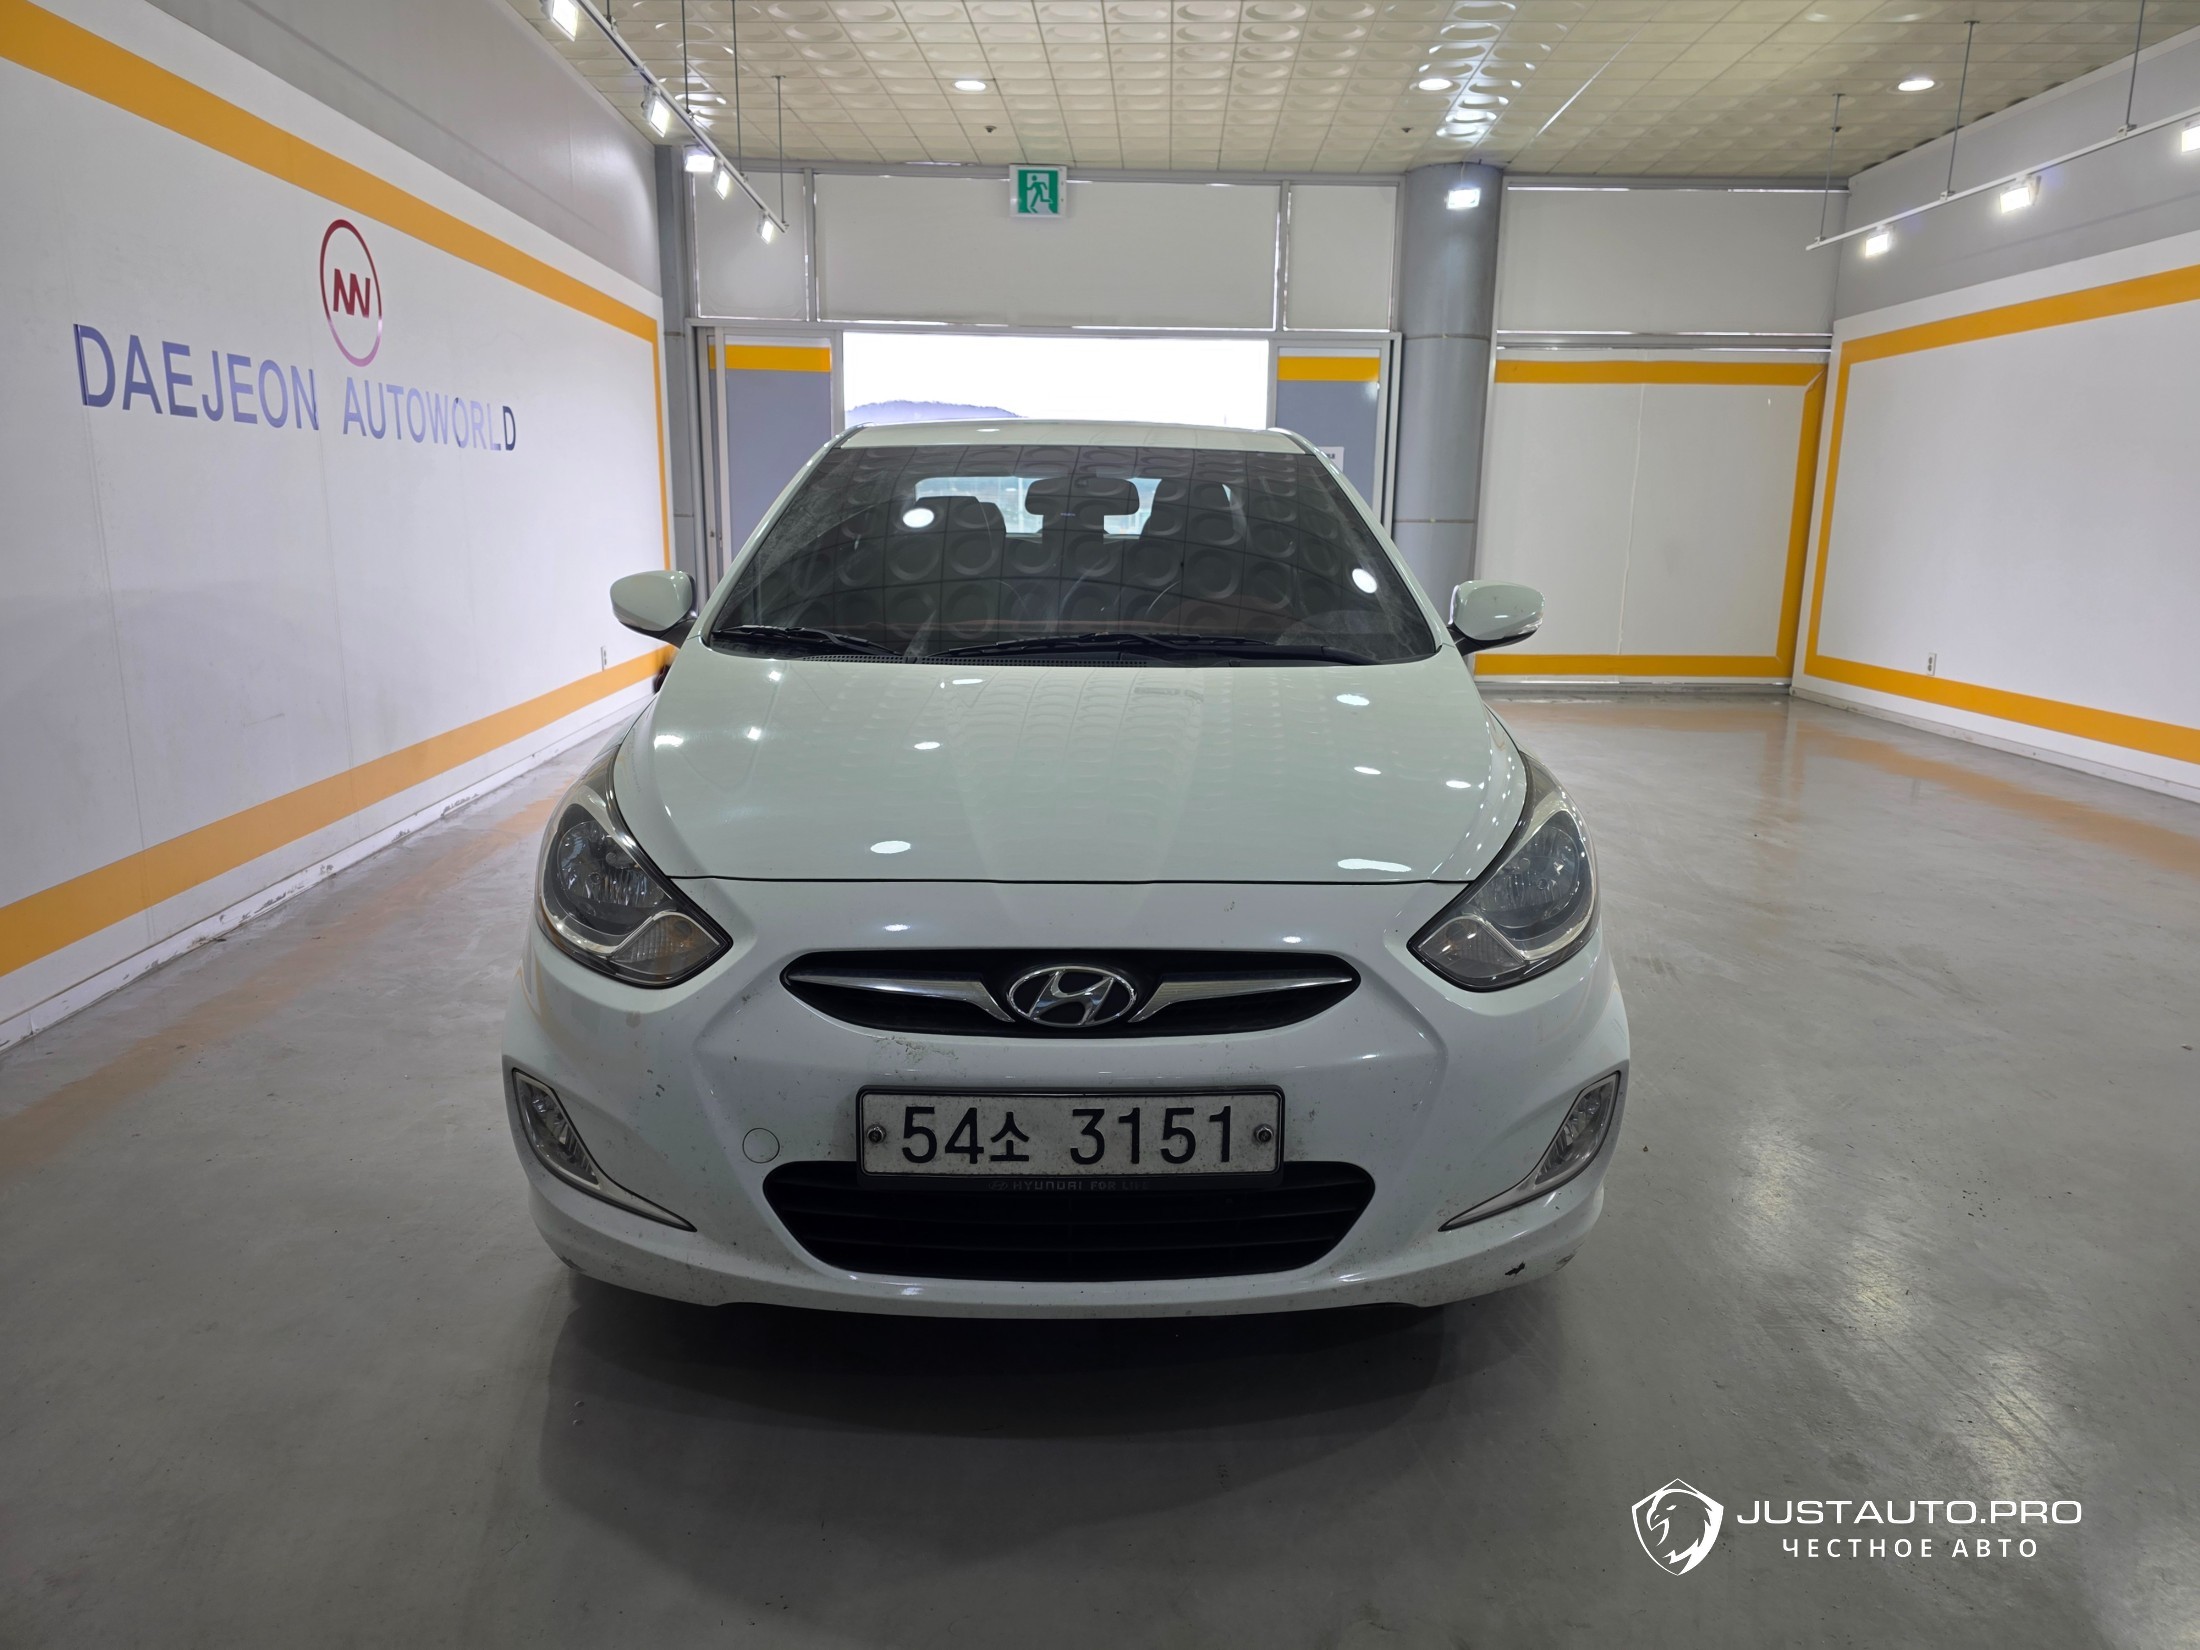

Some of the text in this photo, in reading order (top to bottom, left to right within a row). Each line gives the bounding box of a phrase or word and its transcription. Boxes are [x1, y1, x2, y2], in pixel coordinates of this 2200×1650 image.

[73, 323, 517, 452] DAEJEON AUTOWORLD
[902, 1105, 1232, 1165] 54소 3151
[1013, 1180, 1082, 1191] HYUNDAI
[1090, 1180, 1116, 1191] FOR
